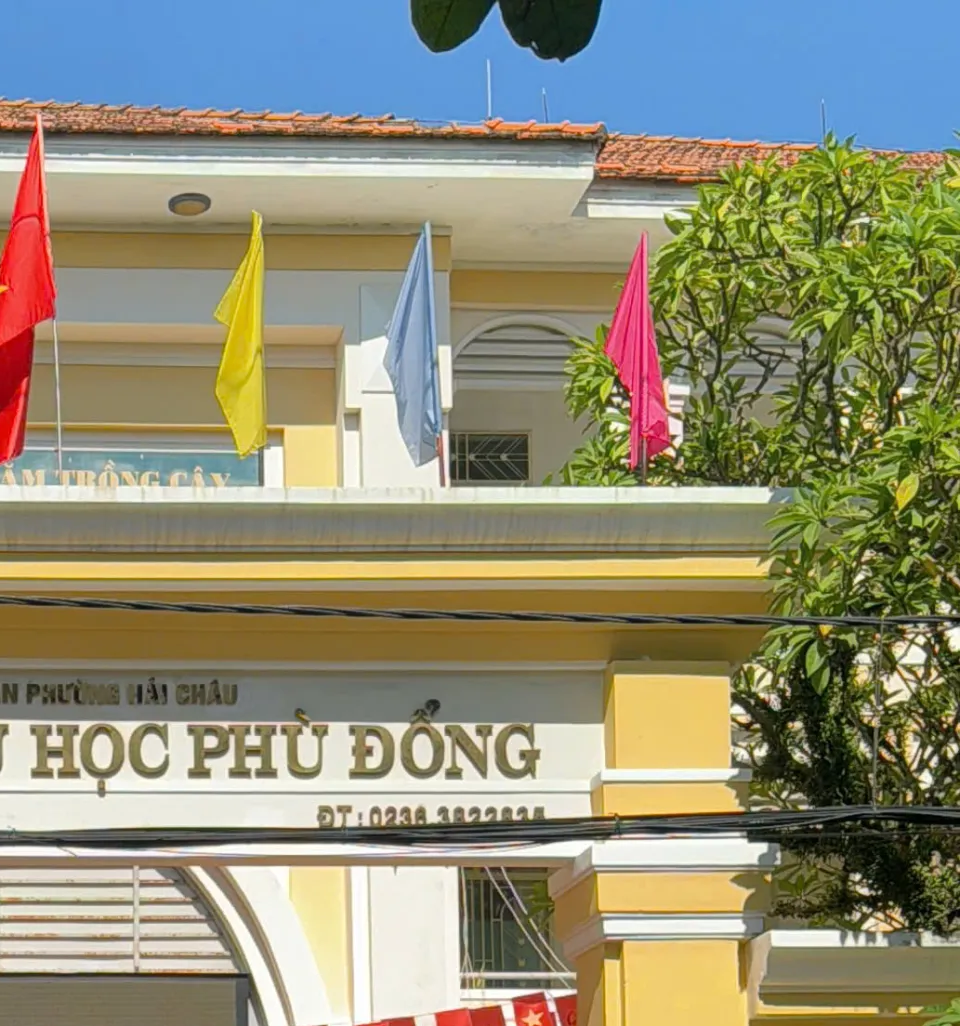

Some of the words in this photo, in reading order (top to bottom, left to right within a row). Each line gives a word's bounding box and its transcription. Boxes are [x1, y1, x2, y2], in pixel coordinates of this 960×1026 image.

[169, 465, 232, 488] CÂY
[26, 679, 120, 705] PHƯỜNG
[126, 677, 168, 705] HẢI
[176, 679, 239, 705] CHÂU
[29, 723, 171, 798] HỌC
[187, 708, 329, 780] PHÙ
[348, 699, 541, 781] ĐỔNG
